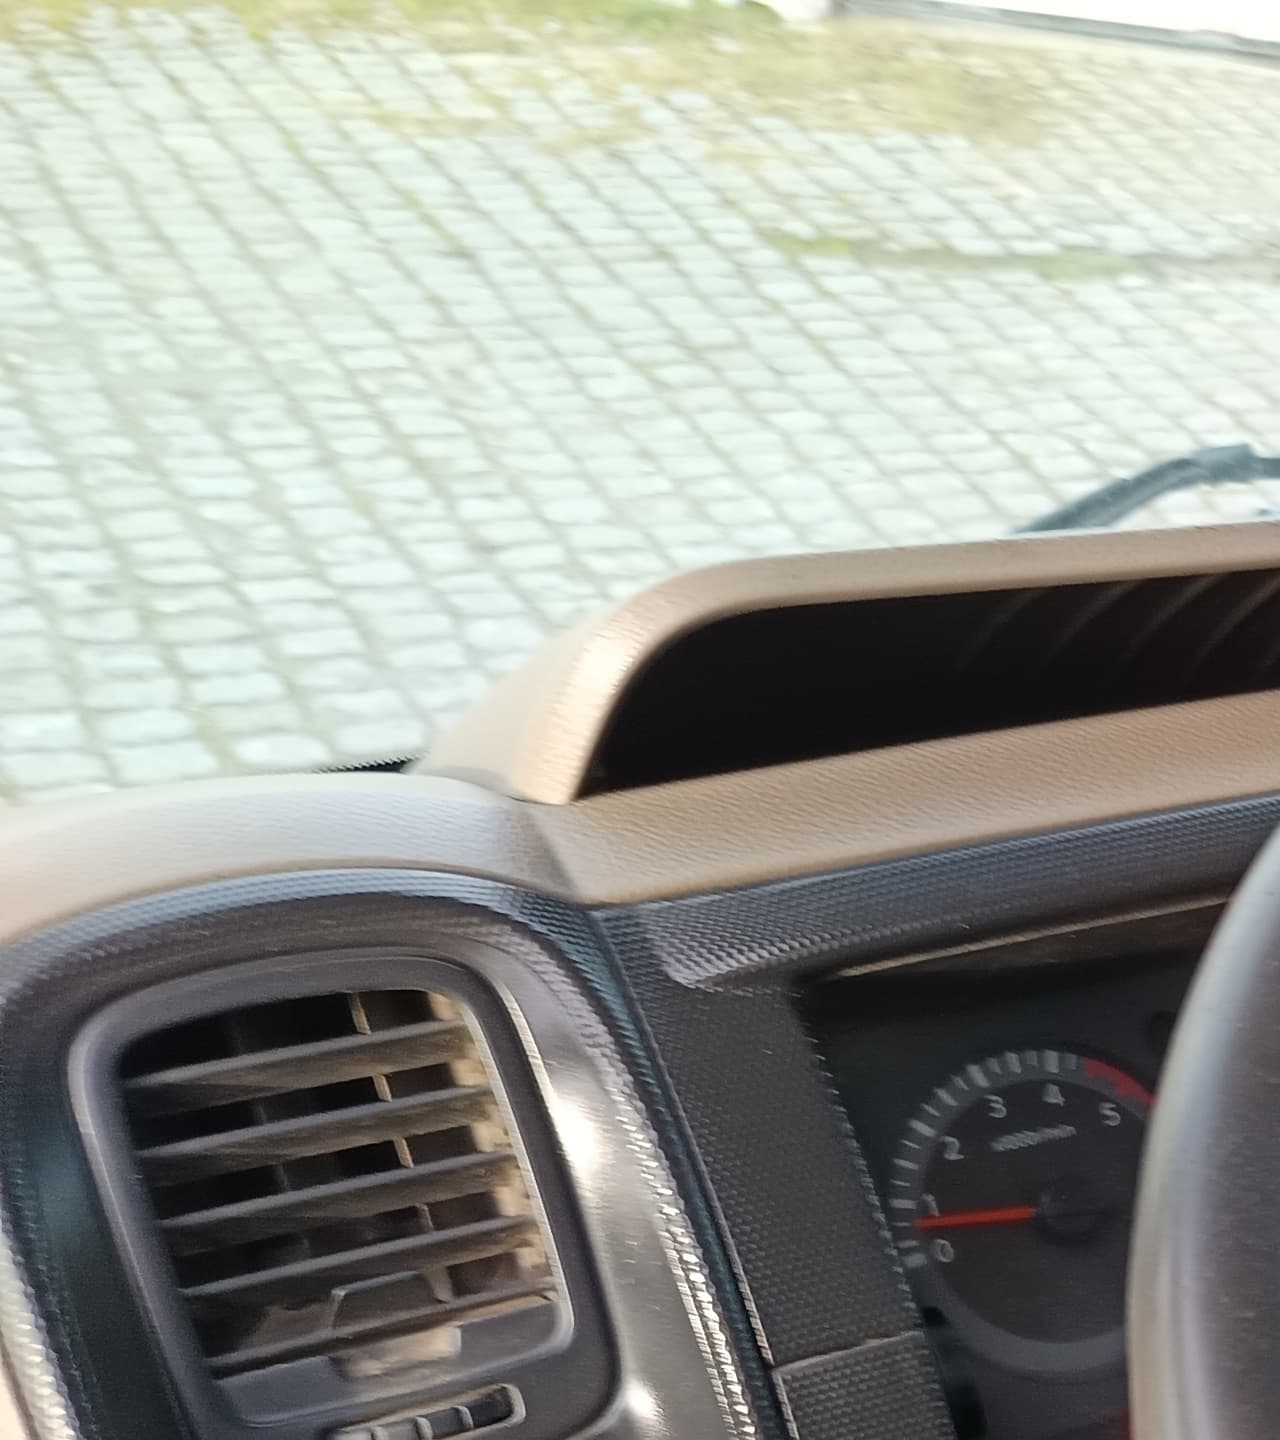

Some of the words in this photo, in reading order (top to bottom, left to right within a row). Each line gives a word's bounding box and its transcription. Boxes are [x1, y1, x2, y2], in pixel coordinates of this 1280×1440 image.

[984, 1094, 1008, 1119] 3
[1043, 1083, 1065, 1107] 4
[1099, 1101, 1121, 1127] 5
[939, 1135, 965, 1161] 2
[932, 1238, 955, 1263] 0
